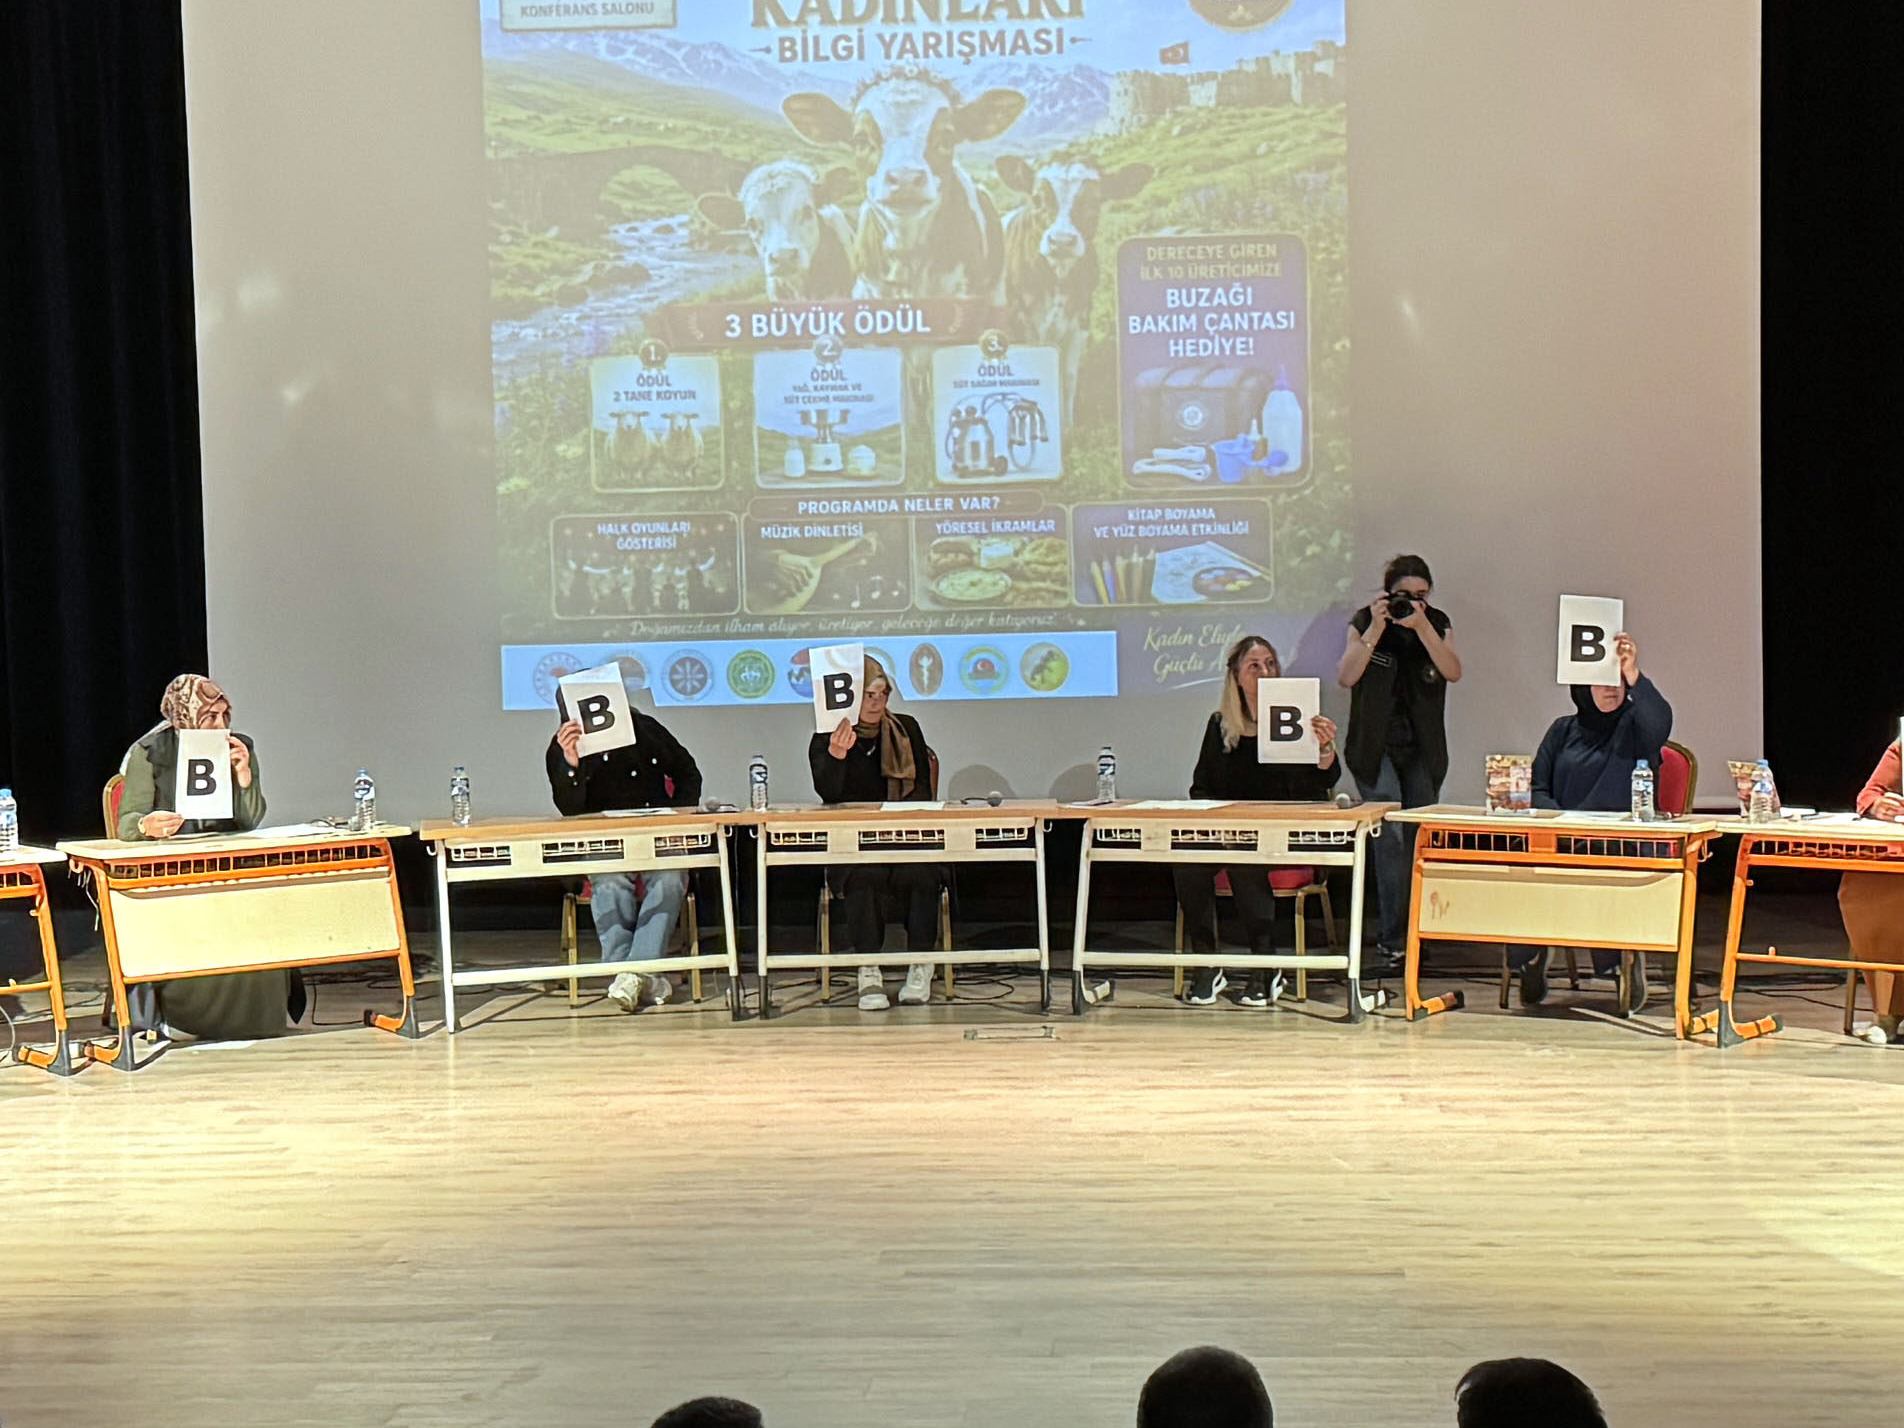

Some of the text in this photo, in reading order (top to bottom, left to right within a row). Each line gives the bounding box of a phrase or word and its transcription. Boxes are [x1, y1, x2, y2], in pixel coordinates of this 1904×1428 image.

[521, 2, 655, 18] KONFERANS SALONU
[778, 28, 1064, 65] BİLGİ YARIŞMASI
[1147, 243, 1277, 261] DERECEYE GİREN
[1166, 283, 1253, 308] BUZAĞI
[724, 304, 931, 338] 3 BÜYÜK ÖDÜL
[1129, 311, 1295, 335] BAKIM ÇANTASI
[649, 345, 662, 361] 1.
[1169, 334, 1254, 357] HEDİYE!
[636, 372, 671, 387] ÖDÜL
[624, 391, 652, 402] TANE
[656, 390, 696, 400] KOYUN
[798, 496, 1000, 514] PROGRAMDA NELER VAR?
[1127, 507, 1215, 521] KİTAP BOYAMA
[598, 521, 690, 535] HALK OYUNLARI
[760, 522, 864, 539] MÜZİK DİNLETİSİ
[936, 518, 1055, 534] YÖRESEL İKRAMLAR
[1094, 525, 1109, 538] VE
[1112, 524, 1136, 538] YÜZ
[1138, 523, 1189, 537] BOYAMA
[616, 535, 677, 550] GÖSTERİSİ
[1144, 626, 1193, 652] Kadın
[1571, 625, 1606, 662] B
[1154, 652, 1204, 684] Güçlü
[823, 672, 854, 710] B
[577, 694, 615, 734] B
[1270, 705, 1303, 742] B
[186, 758, 217, 796] B
